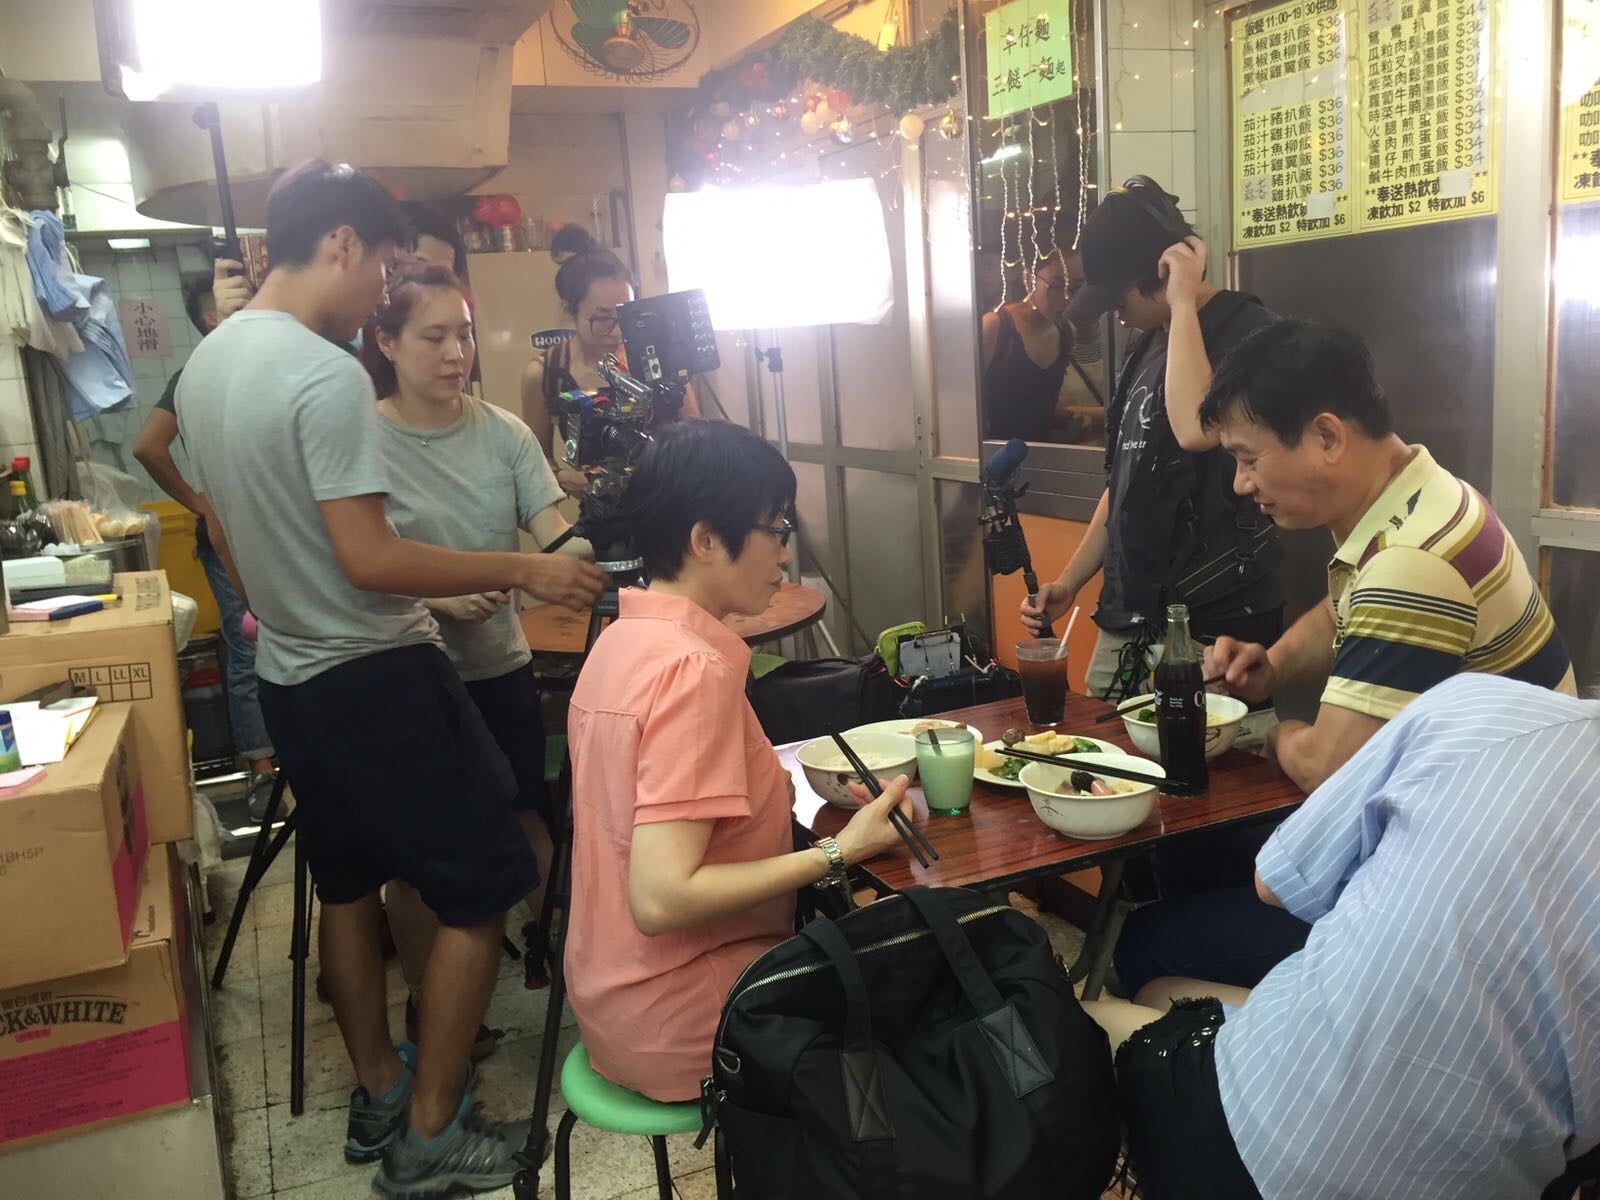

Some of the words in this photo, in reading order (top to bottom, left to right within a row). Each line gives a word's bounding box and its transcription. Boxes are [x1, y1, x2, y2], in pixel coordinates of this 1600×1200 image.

[1317, 46, 1341, 65] $36
[1243, 105, 1312, 133] 茄汁豬扒飯
[1318, 96, 1344, 114] $36
[1243, 120, 1312, 148] 茄汁雞扒飯
[1318, 112, 1344, 130] $36
[1455, 119, 1486, 137] $34
[1243, 136, 1312, 162] 茄汁魚柳飯
[1318, 127, 1344, 146] $36
[1455, 135, 1486, 153] $34
[1243, 152, 1312, 177] 茄汁雞翼飯
[1318, 145, 1345, 162] $36
[1454, 151, 1486, 170] $34
[1271, 168, 1313, 188] 豬扒飯
[1319, 161, 1344, 178] $36
[1271, 184, 1313, 203] 雞扒飯
[1319, 178, 1344, 193] $36
[1408, 200, 1422, 214] $2
[1471, 190, 1486, 205] $6
[1280, 221, 1291, 233] $2
[1334, 213, 1346, 226] $6
[133, 302, 159, 352] 小心地滑
[74, 671, 86, 684] M
[96, 670, 103, 682] L
[113, 668, 127, 681] LL
[133, 666, 149, 679] XL
